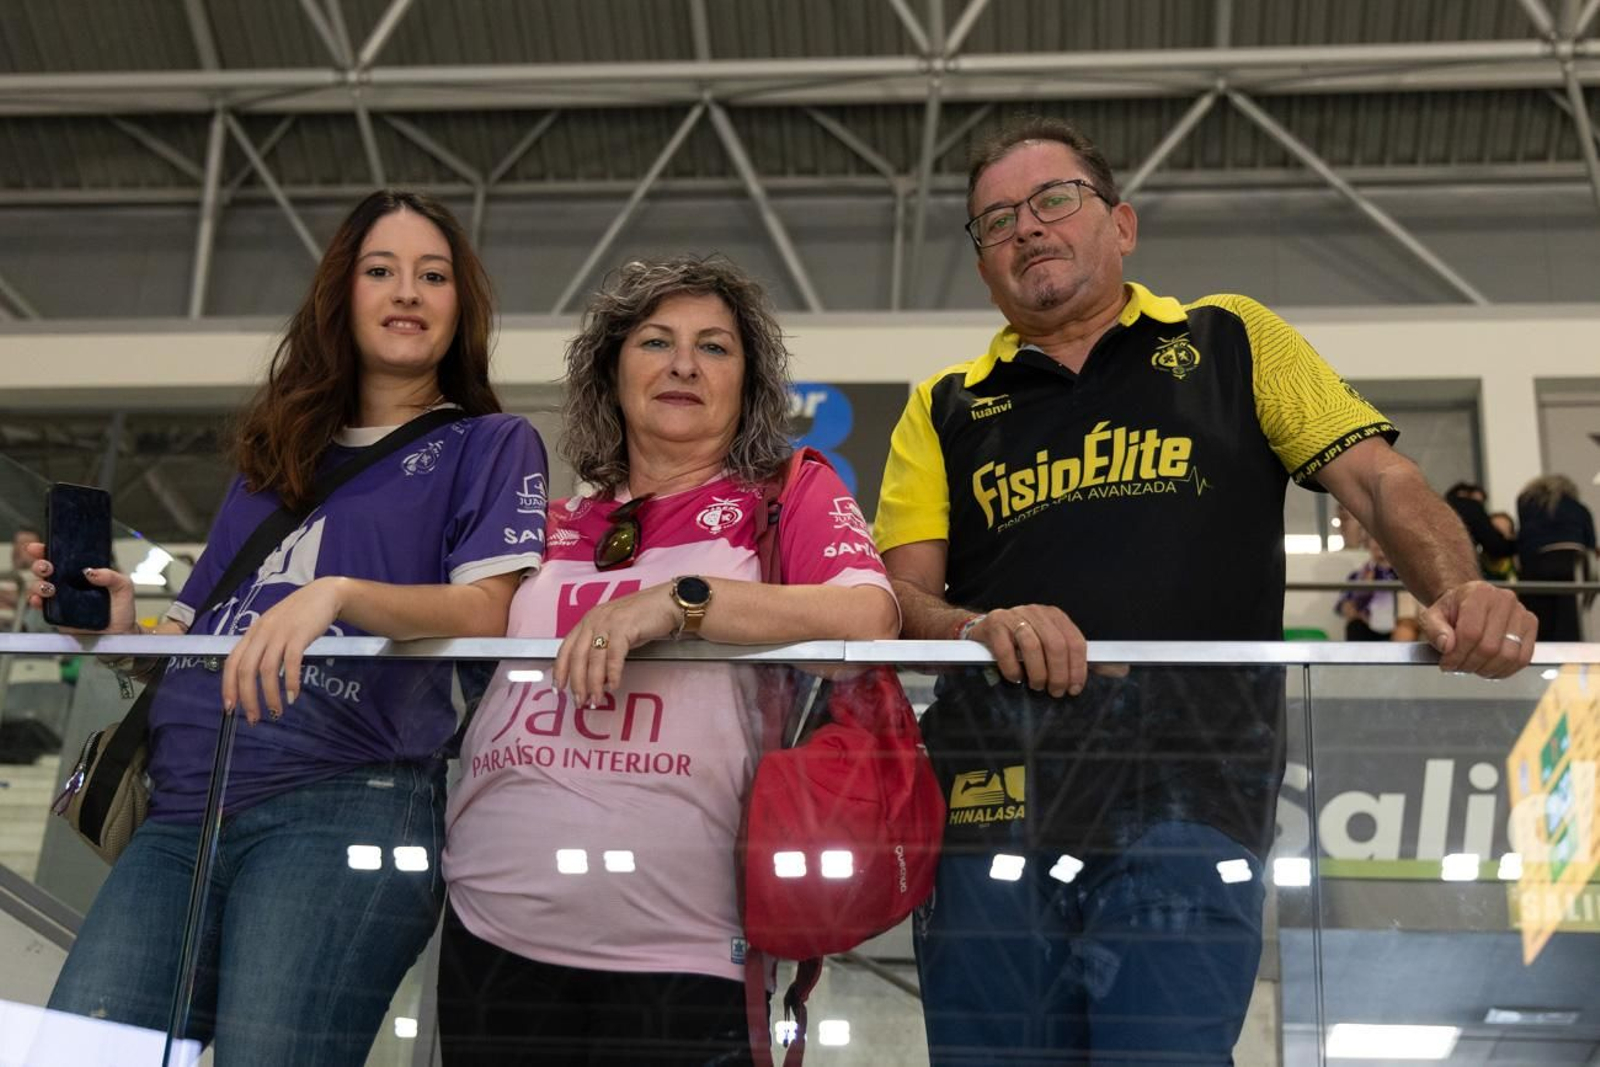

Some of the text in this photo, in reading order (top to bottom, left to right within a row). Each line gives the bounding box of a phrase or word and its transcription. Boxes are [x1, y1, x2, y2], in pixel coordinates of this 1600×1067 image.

[1323, 445, 1342, 462] JPI
[1344, 433, 1363, 447] JPI
[971, 420, 1193, 530] FisioÉlite
[1087, 480, 1178, 500] AVANZADA
[472, 737, 692, 778] PARAÍSO INTERIOR
